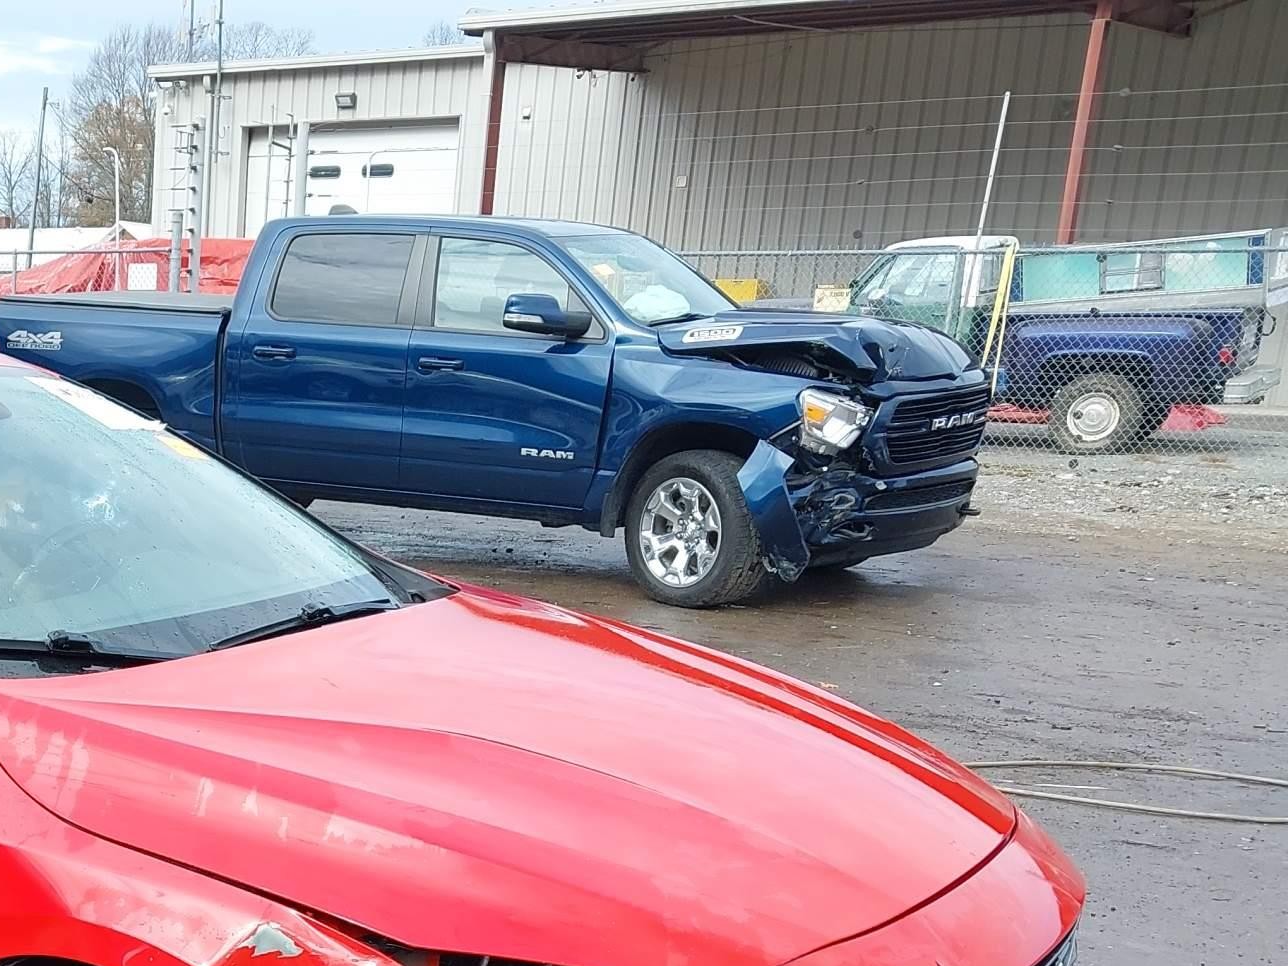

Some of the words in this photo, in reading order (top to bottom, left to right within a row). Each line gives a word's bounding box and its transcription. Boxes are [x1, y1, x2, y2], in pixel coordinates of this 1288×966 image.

[7, 330, 64, 346] 4x4
[931, 412, 975, 431] RAM
[520, 447, 575, 460] RAM
